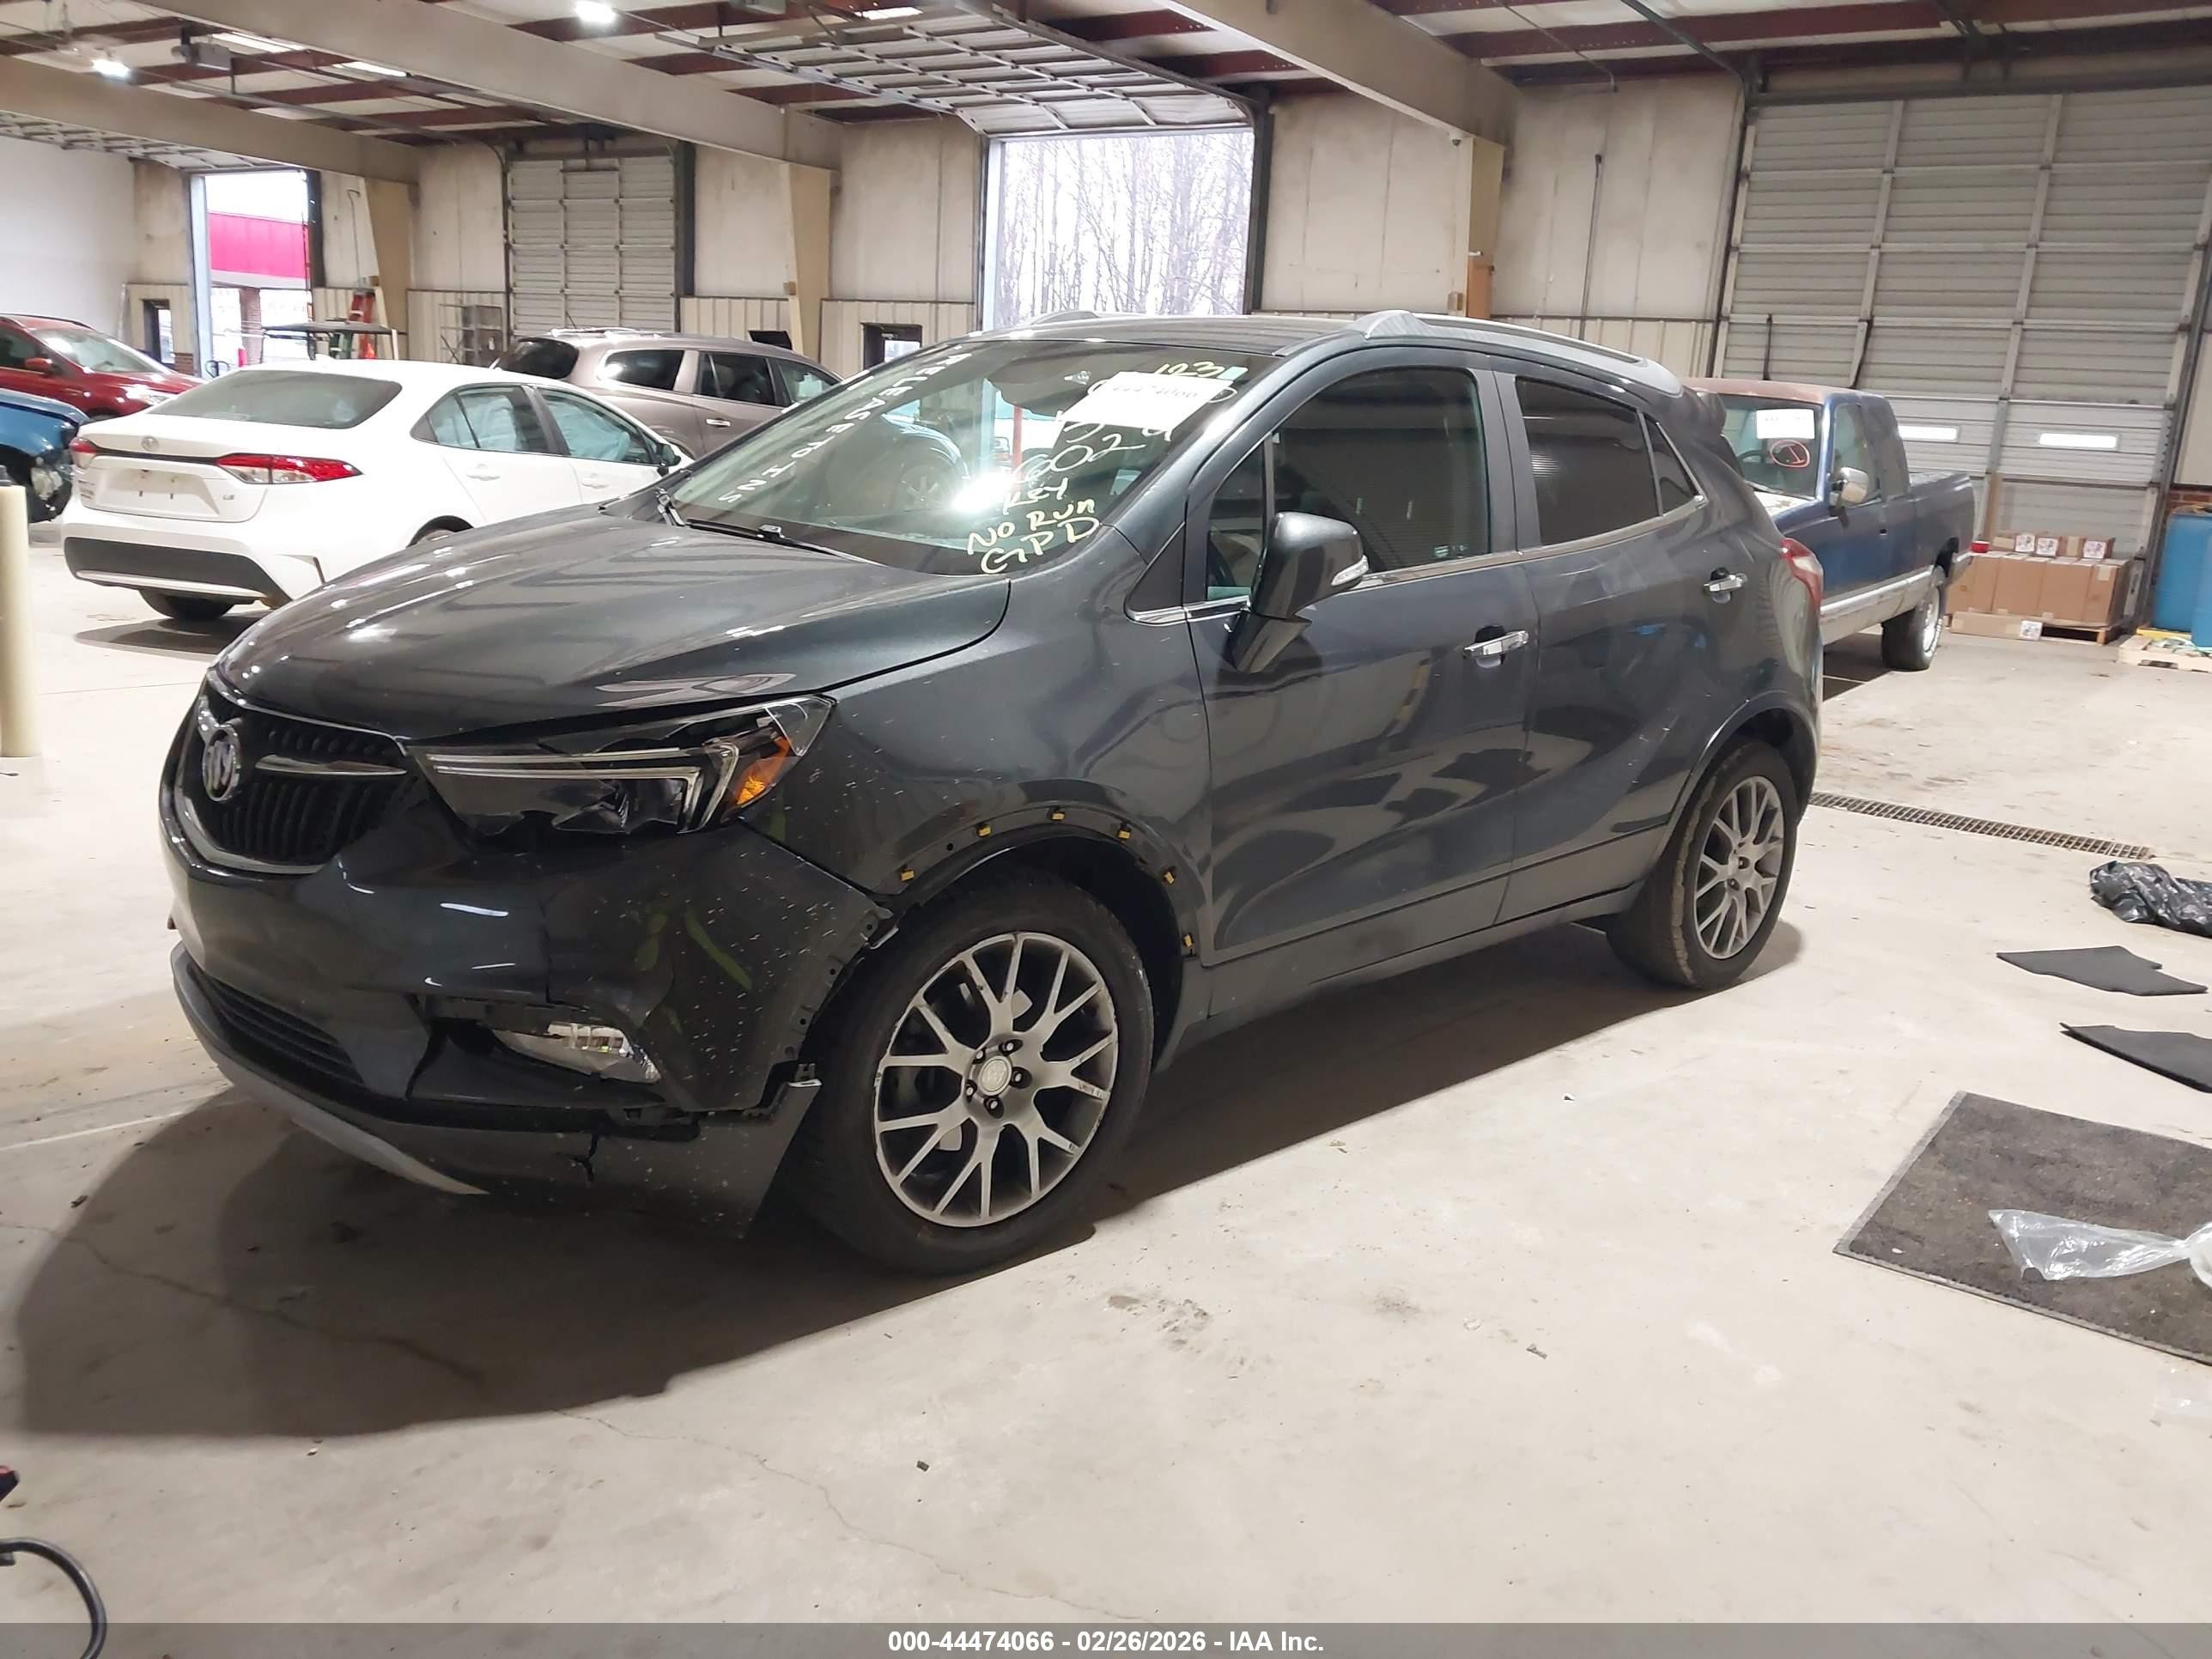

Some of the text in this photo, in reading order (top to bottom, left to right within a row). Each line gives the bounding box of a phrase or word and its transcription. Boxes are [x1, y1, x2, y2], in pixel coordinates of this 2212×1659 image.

[825, 353, 972, 434] RELEASE
[718, 461, 797, 503] INS
[967, 520, 1016, 556] NO
